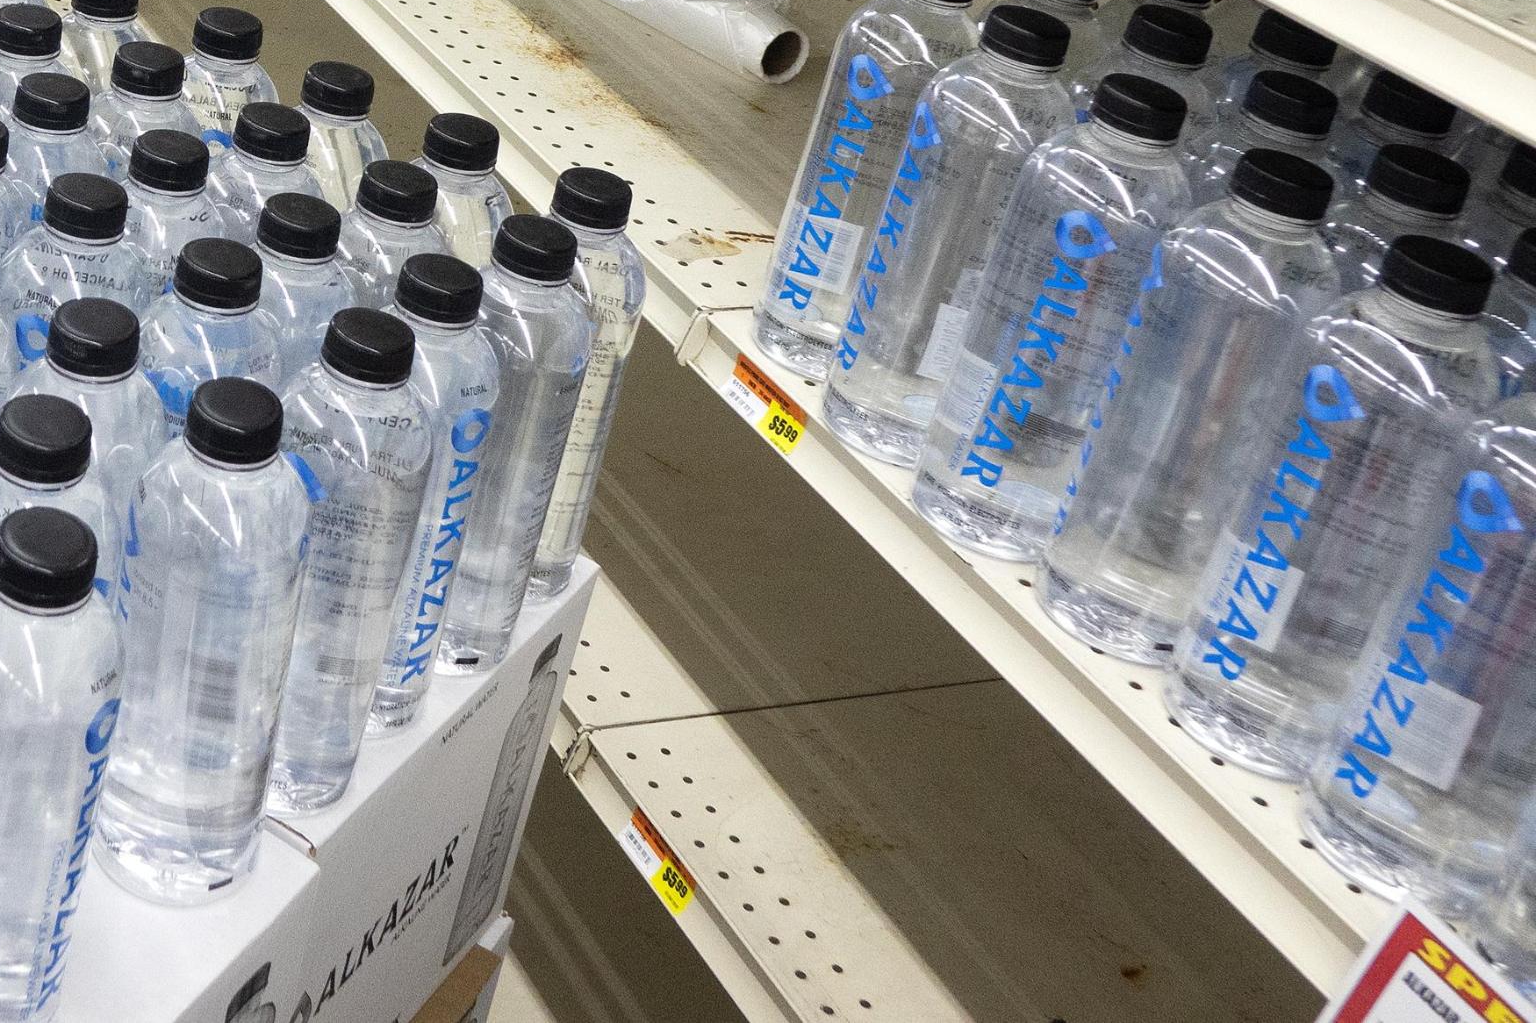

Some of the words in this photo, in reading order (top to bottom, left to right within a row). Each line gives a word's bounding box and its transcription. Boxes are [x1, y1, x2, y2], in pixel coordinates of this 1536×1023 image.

[779, 99, 875, 311] ALKAZAR
[835, 152, 923, 371] ALKAZAR
[460, 384, 488, 399] NATURAL
[768, 415, 798, 443] $599
[961, 256, 1089, 488] ALKAZAR
[400, 458, 479, 686] ALKAZAR
[411, 523, 434, 584] PREMIUM
[1203, 416, 1333, 682] ALKAZAR
[1334, 524, 1486, 799] ALKAZAR
[312, 835, 461, 1018] ALKAZAR
[662, 867, 688, 898] $599
